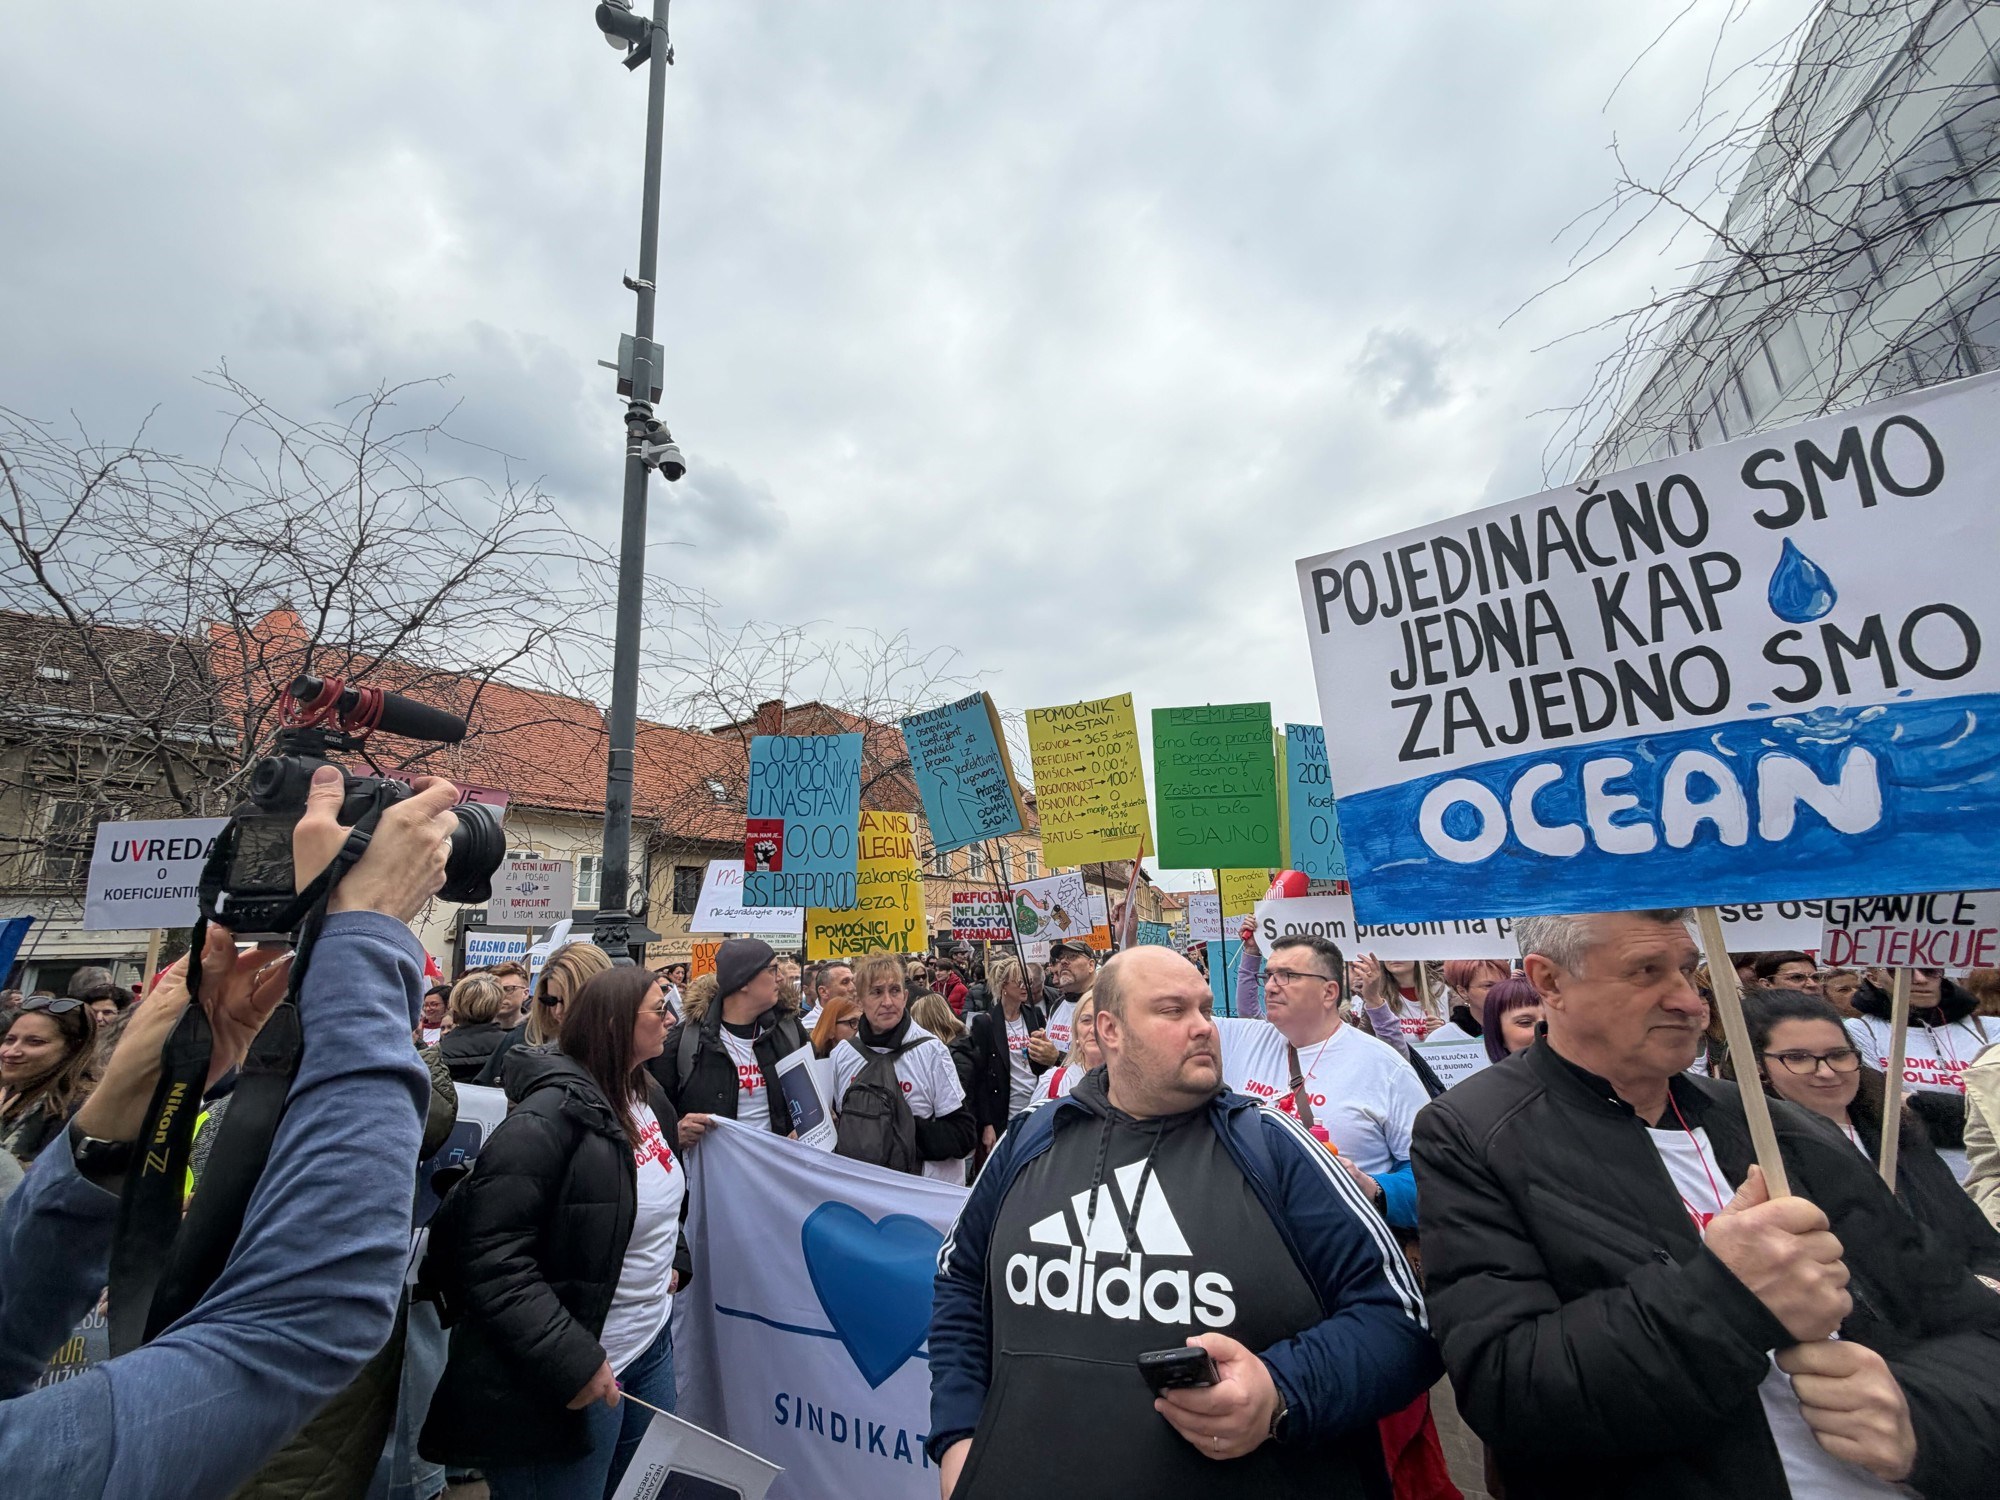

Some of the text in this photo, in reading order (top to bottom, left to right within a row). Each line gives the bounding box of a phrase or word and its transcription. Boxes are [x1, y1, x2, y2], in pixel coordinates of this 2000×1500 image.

[1312, 415, 1944, 634] POJEDINAČNO SMO
[1391, 551, 1741, 690] JEDNA KAP
[1392, 603, 1981, 761] ZAJEDNO SMO
[1123, 695, 1131, 707] U
[1170, 706, 1269, 724] PREMIJERU
[770, 735, 842, 763] ODBOR
[1031, 729, 1134, 751] UGOVOR 365 dana
[1155, 735, 1185, 749] Crna
[1190, 731, 1222, 747] Gora
[925, 756, 953, 772] prava
[955, 747, 998, 775] kolektivnih
[1032, 751, 1084, 766] KOEFICIJENT
[1097, 742, 1121, 758] 0,00
[1155, 749, 1261, 774] je POMOĆNIKE
[1034, 767, 1074, 780] POVIŠICA
[1092, 758, 1118, 774] 0,00
[1190, 761, 1248, 776] davno!
[1036, 779, 1094, 797] ODGOVORNOST
[1107, 771, 1128, 786] 100
[1204, 785, 1218, 794] ne
[750, 788, 851, 816] U NASTAVI
[1039, 795, 1088, 811] OSNOVICA
[1111, 802, 1119, 810] od
[1170, 805, 1186, 818] To
[1308, 792, 1335, 814] koef
[1419, 745, 1882, 861] OCEAN
[882, 815, 918, 834] NISU
[982, 810, 1013, 829] SADA!
[786, 825, 849, 865] 0,00
[1041, 829, 1083, 844] STATUS
[1177, 824, 1269, 846] SJAJNO
[1310, 815, 1342, 855] 0,
[111, 838, 216, 862] UVREDA
[858, 835, 921, 860] ILEGIJA!
[157, 868, 167, 879] O
[1294, 853, 1317, 874] do
[525, 873, 549, 881] POSAO
[716, 869, 744, 885] Mo
[857, 868, 924, 884] zakonska
[744, 871, 857, 907] ŠS PREPOROD
[511, 898, 551, 907] KOEFICIJENT
[953, 905, 1009, 916] INFLACIJA
[502, 911, 507, 919] U
[538, 910, 566, 919] SEKTORU
[953, 917, 1012, 927] ŠKOLSTVU
[815, 917, 915, 939] POMOĆNICI U
[1264, 918, 1278, 940] S
[1285, 918, 1346, 939] ovom
[469, 940, 526, 952] GLASNO GOV
[1822, 926, 2000, 967] DETEKCIJE
[154, 1083, 187, 1143] Nikon
[1006, 1245, 1236, 1328] adidas
[775, 1392, 929, 1469] SINDIKAT
[642, 1465, 664, 1500] NEZAVIS
